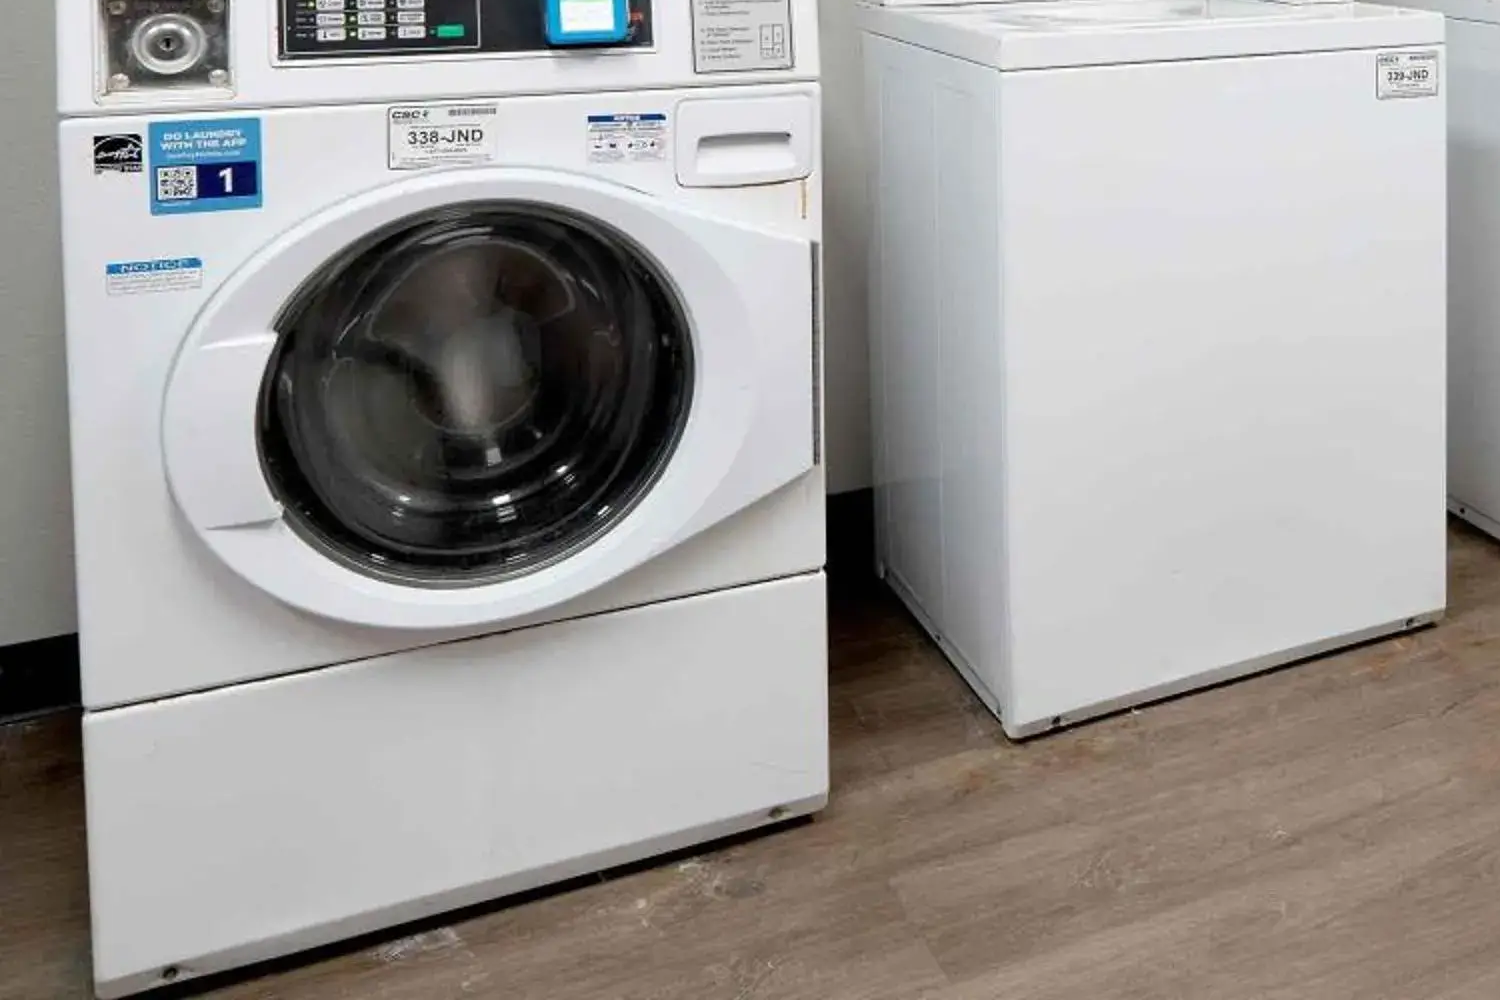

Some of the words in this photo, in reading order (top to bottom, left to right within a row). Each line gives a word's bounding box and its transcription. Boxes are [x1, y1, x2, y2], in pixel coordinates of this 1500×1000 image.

[163, 132, 182, 141] DO
[185, 129, 242, 141] LAUNDRY
[407, 129, 483, 145] 338-JND
[160, 141, 193, 151] WITH
[196, 139, 220, 149] THE
[222, 138, 247, 148] APP
[218, 167, 233, 193] 1
